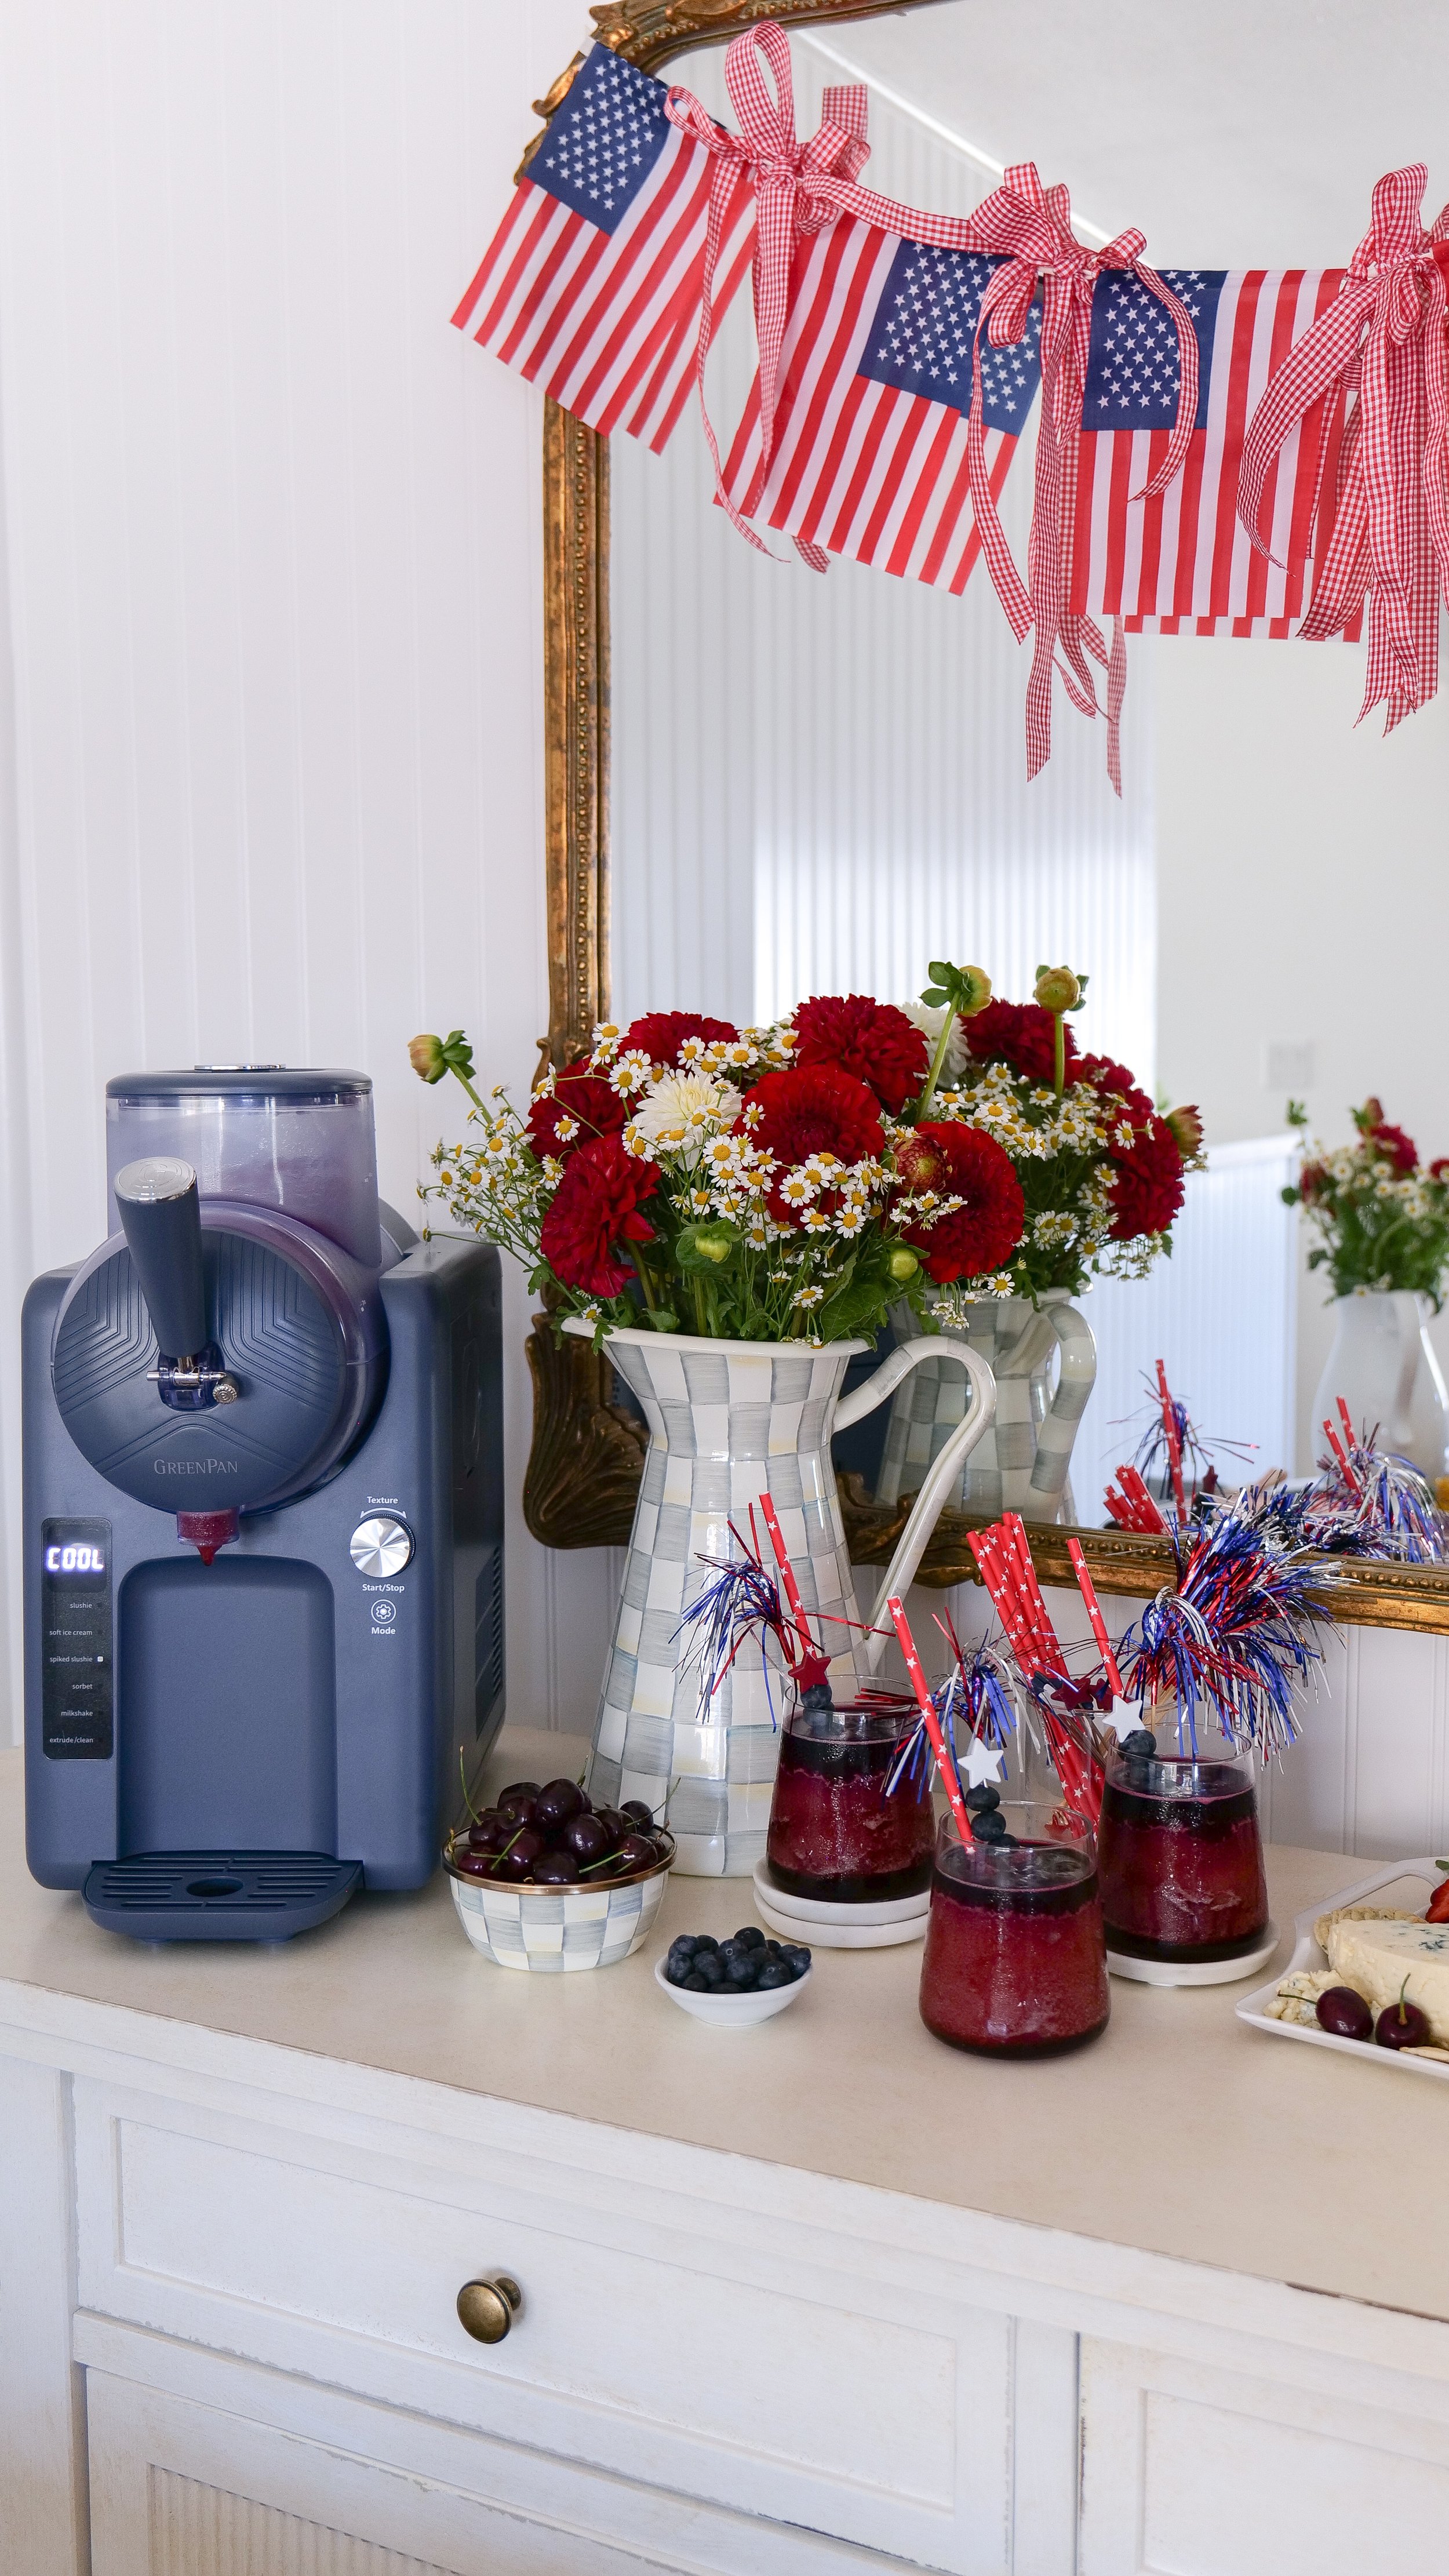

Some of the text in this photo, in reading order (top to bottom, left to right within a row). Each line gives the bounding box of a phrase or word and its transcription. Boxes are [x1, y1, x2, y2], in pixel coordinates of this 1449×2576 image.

[366, 1496, 399, 1504] Texture
[46, 1547, 104, 1570] COOL
[362, 1584, 405, 1593] Start/Stop
[371, 1627, 396, 1635] Mode
[50, 1656, 70, 1664] spiked
[49, 1736, 93, 1744] extrude/clean
